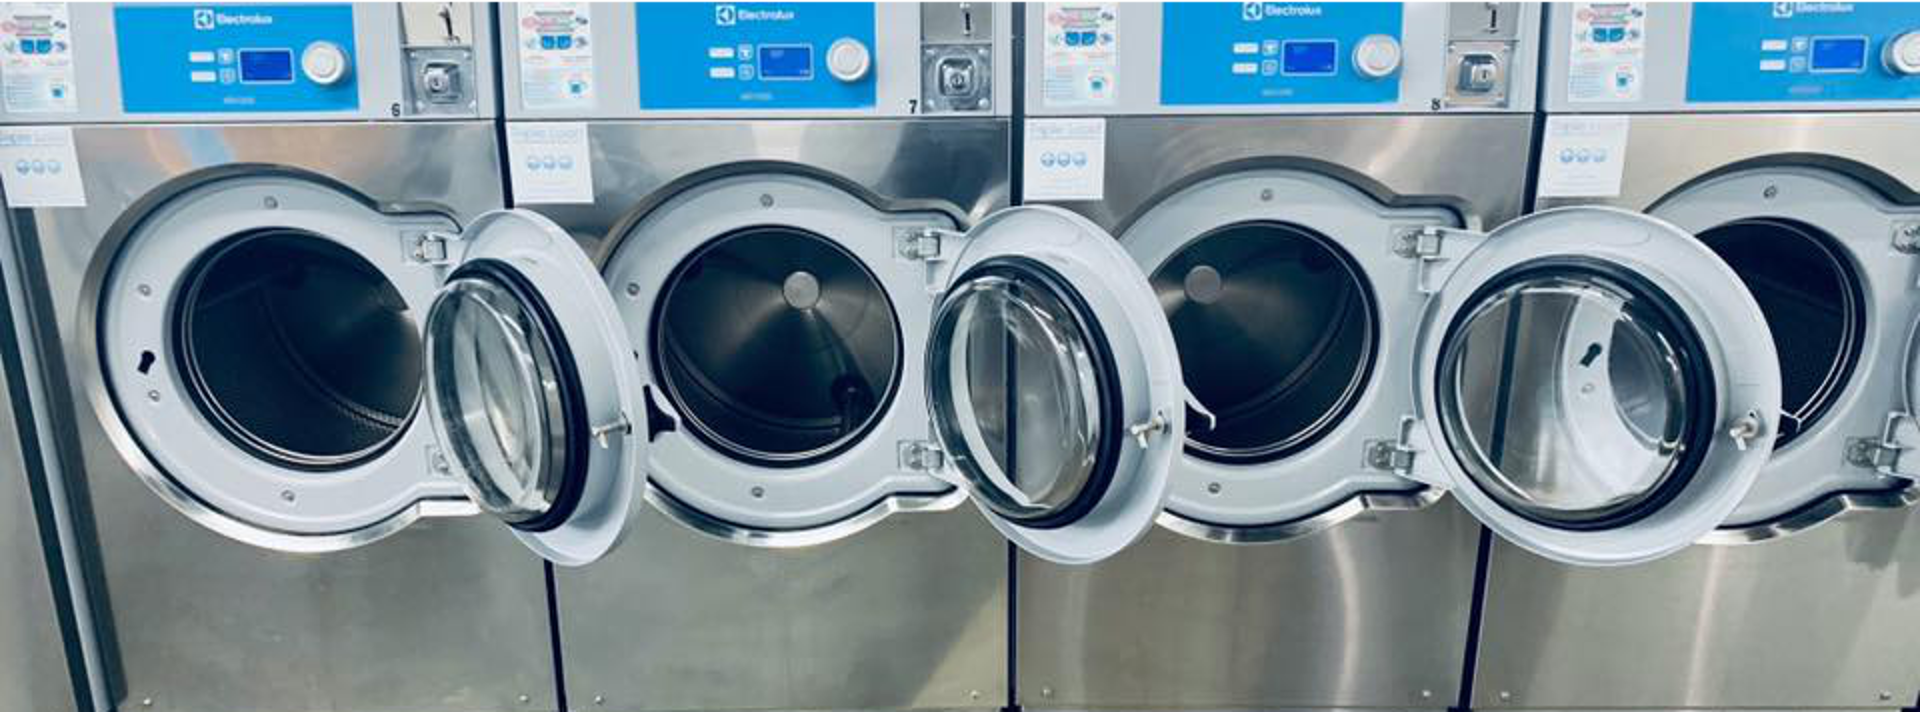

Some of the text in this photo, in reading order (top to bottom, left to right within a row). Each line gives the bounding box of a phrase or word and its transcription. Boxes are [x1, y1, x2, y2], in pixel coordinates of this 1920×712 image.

[1265, 4, 1322, 16] Electrolux
[1796, 0, 1855, 13] Electrolux
[216, 13, 272, 25] Electrolux
[738, 9, 794, 21] Electrolux
[391, 102, 401, 117] 6
[908, 99, 918, 115] 7
[1431, 97, 1441, 111] 8
